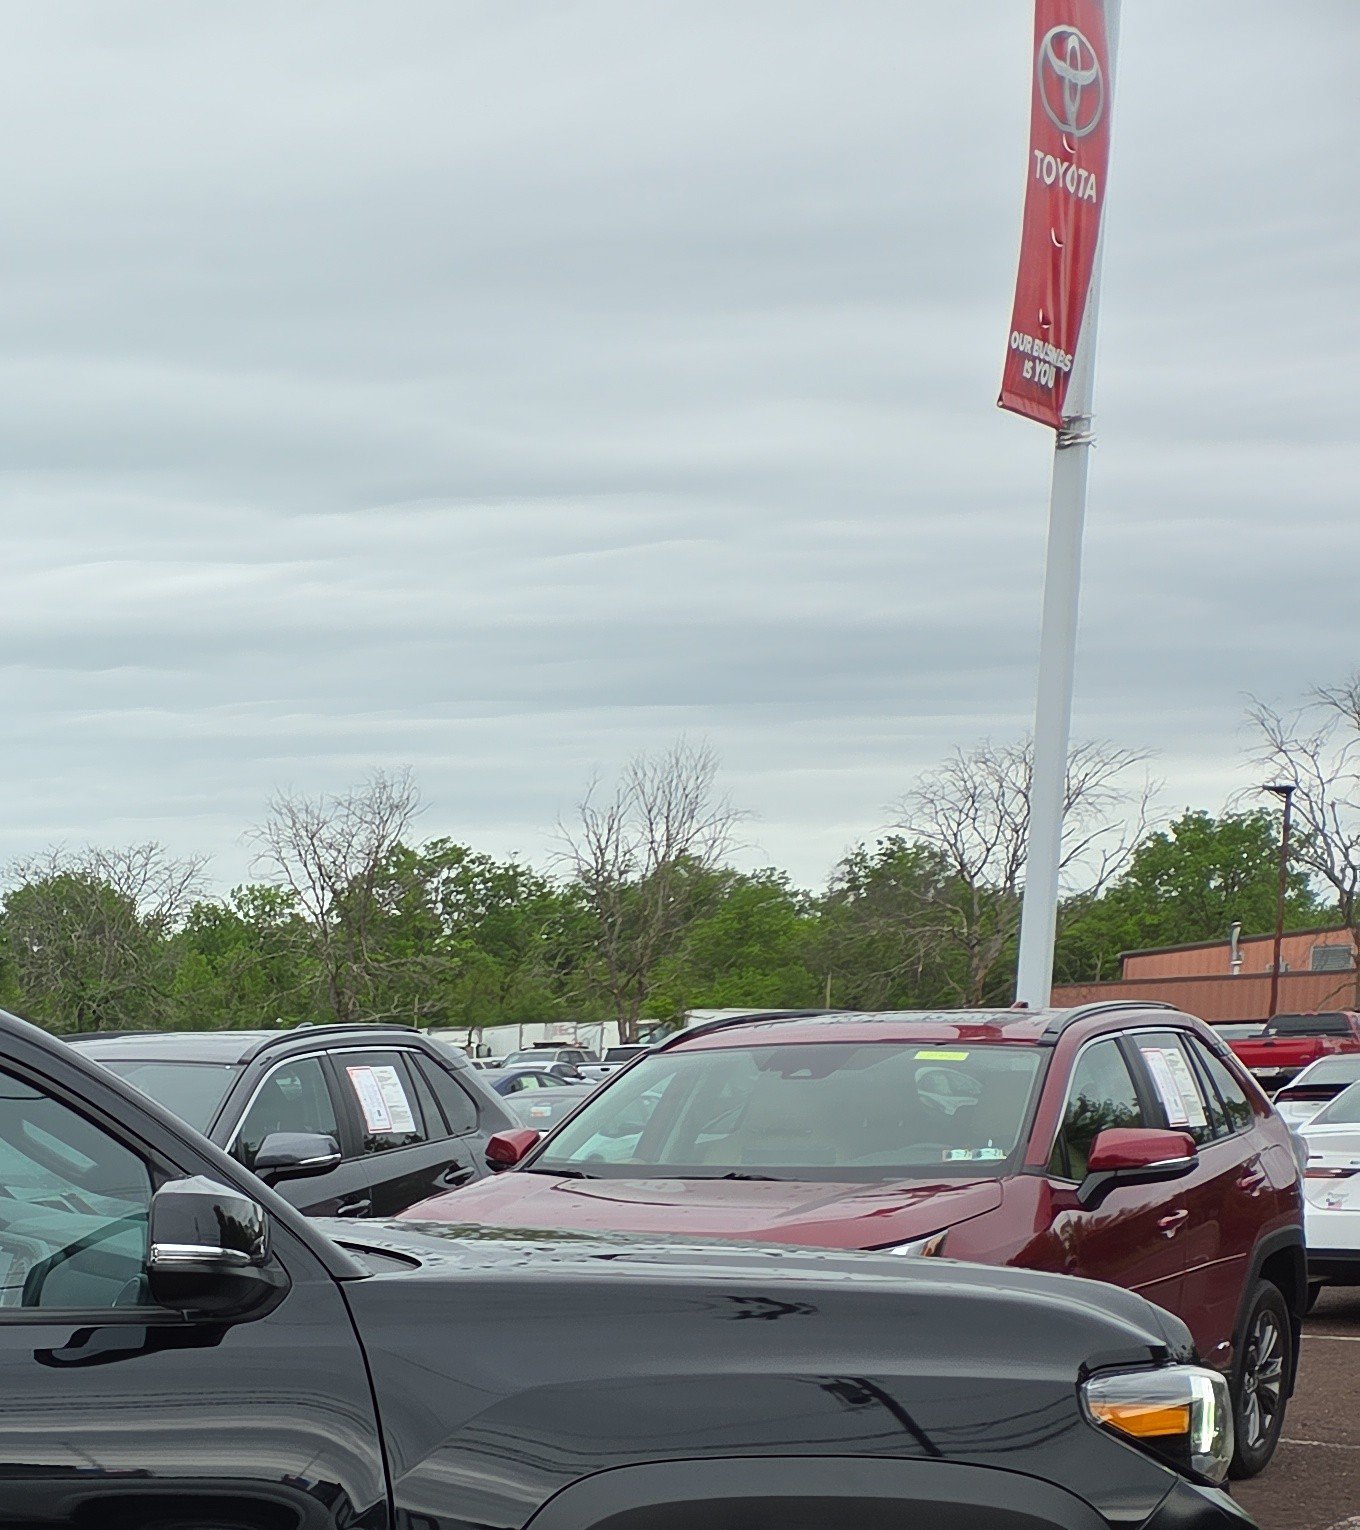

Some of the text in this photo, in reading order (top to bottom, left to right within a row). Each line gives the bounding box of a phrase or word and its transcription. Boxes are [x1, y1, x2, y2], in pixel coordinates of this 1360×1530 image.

[1034, 150, 1096, 203] TOYOTA
[1011, 331, 1033, 355] OUR
[1023, 358, 1057, 388] IS YOU
